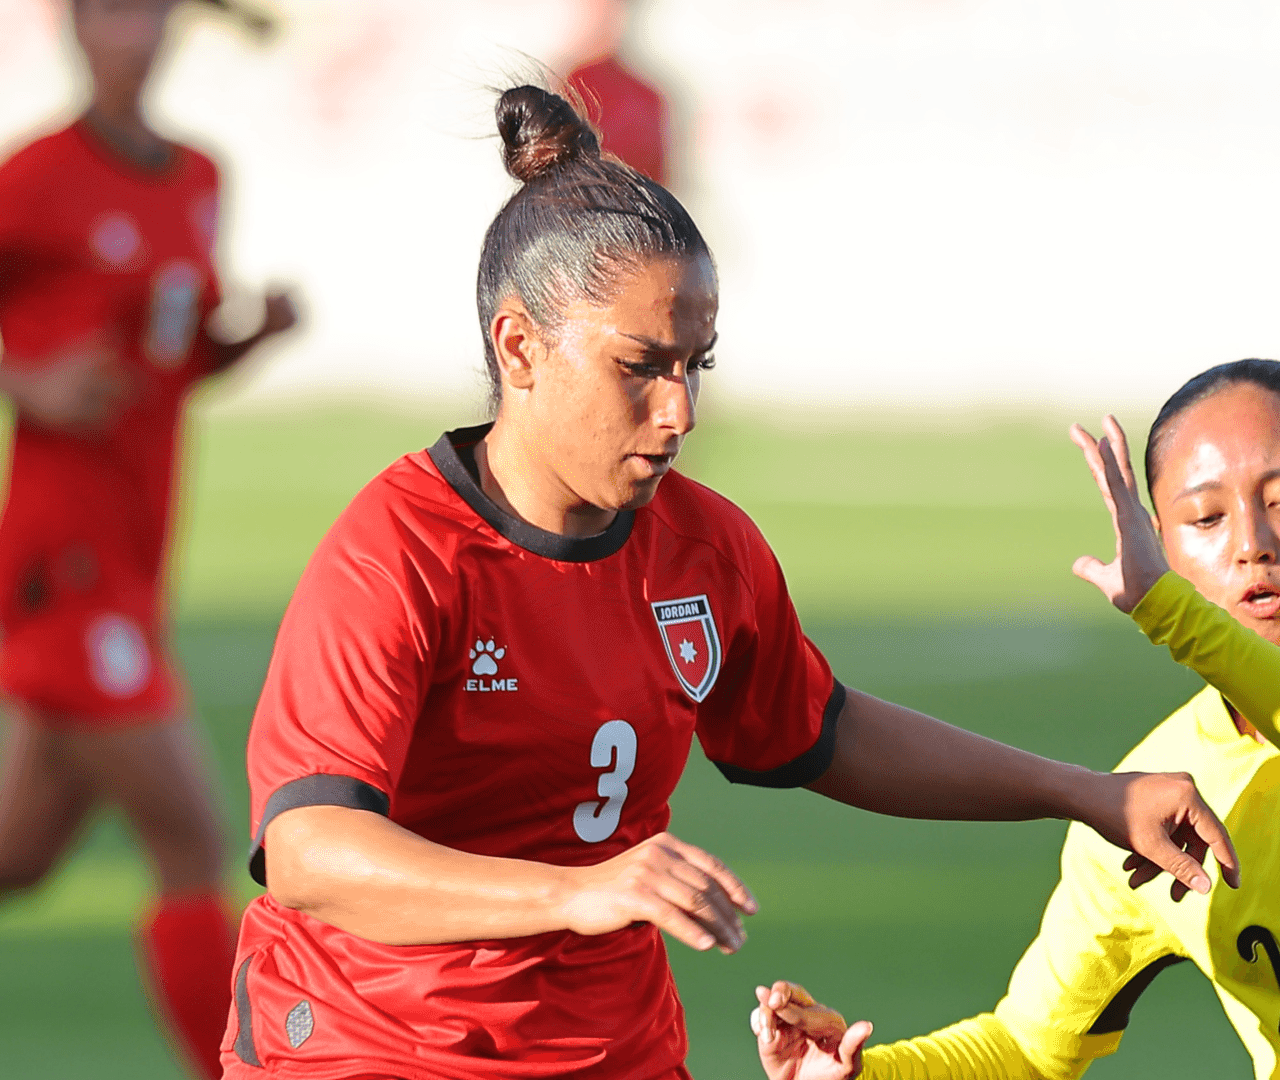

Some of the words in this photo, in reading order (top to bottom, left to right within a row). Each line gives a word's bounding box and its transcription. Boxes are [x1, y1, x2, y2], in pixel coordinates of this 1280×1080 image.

[661, 602, 700, 620] JORDAN
[462, 678, 518, 691] ELME
[573, 720, 637, 843] 3
